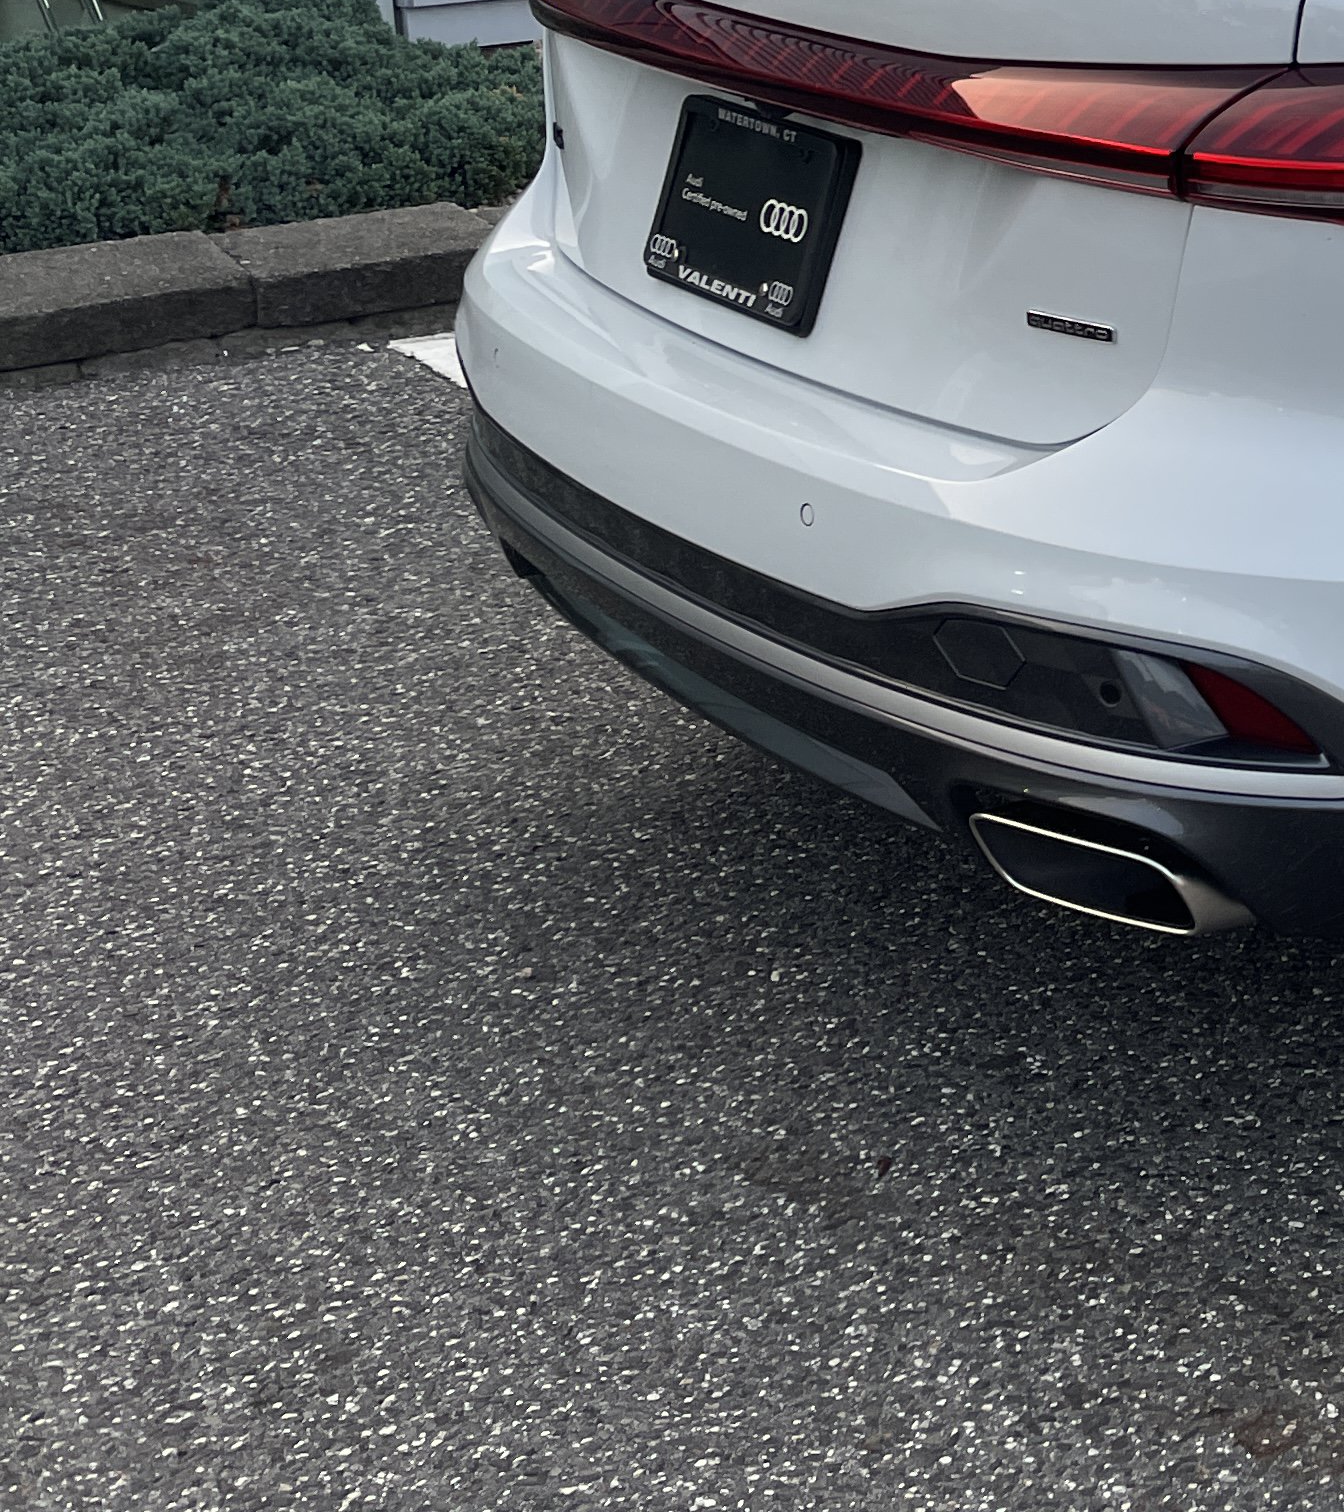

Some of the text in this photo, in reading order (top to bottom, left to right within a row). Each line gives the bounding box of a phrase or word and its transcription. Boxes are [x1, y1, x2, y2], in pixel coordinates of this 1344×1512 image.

[717, 107, 798, 143] WATERTOWN, CT
[677, 264, 757, 308] VALENTI
